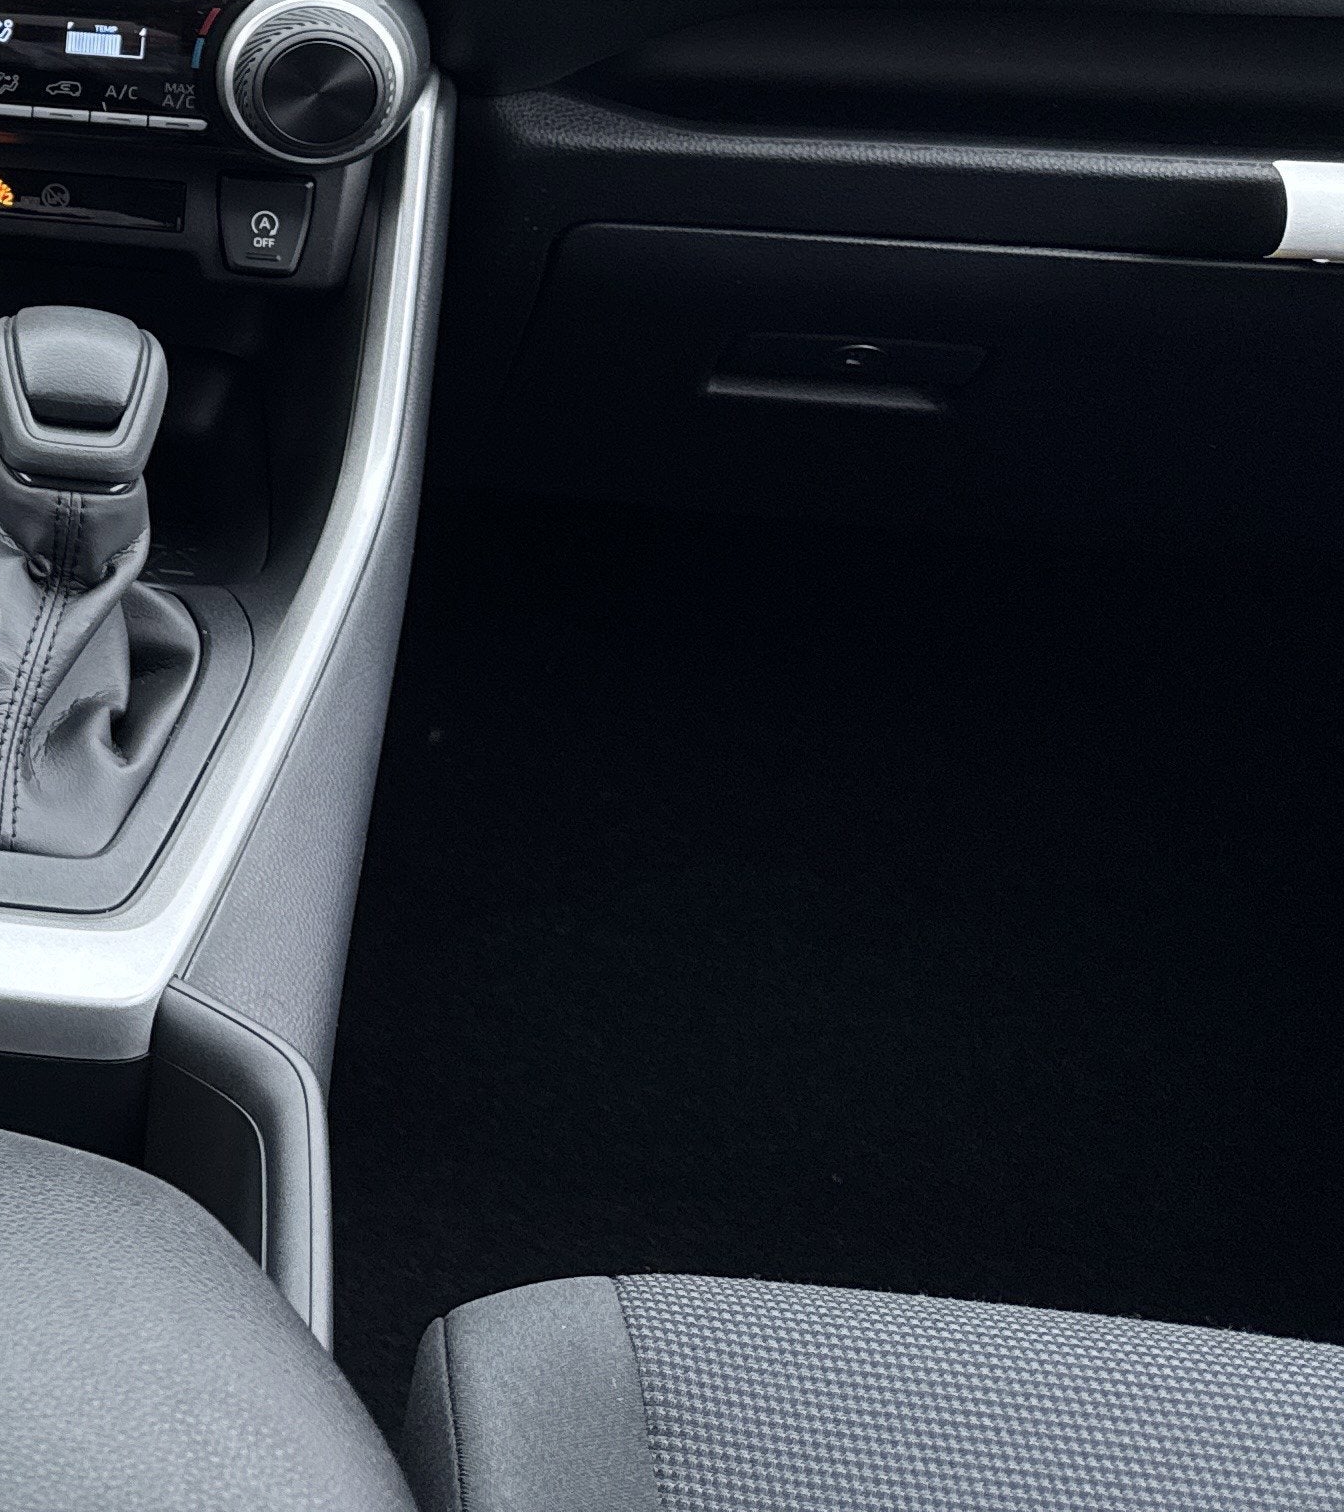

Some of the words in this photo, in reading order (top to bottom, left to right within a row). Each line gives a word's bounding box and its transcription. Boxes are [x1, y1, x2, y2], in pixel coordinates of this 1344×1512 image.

[94, 24, 118, 34] TEMP
[105, 85, 139, 101] A/C
[164, 82, 195, 95] MAX
[162, 94, 197, 110] A/C
[253, 236, 276, 248] OFF
